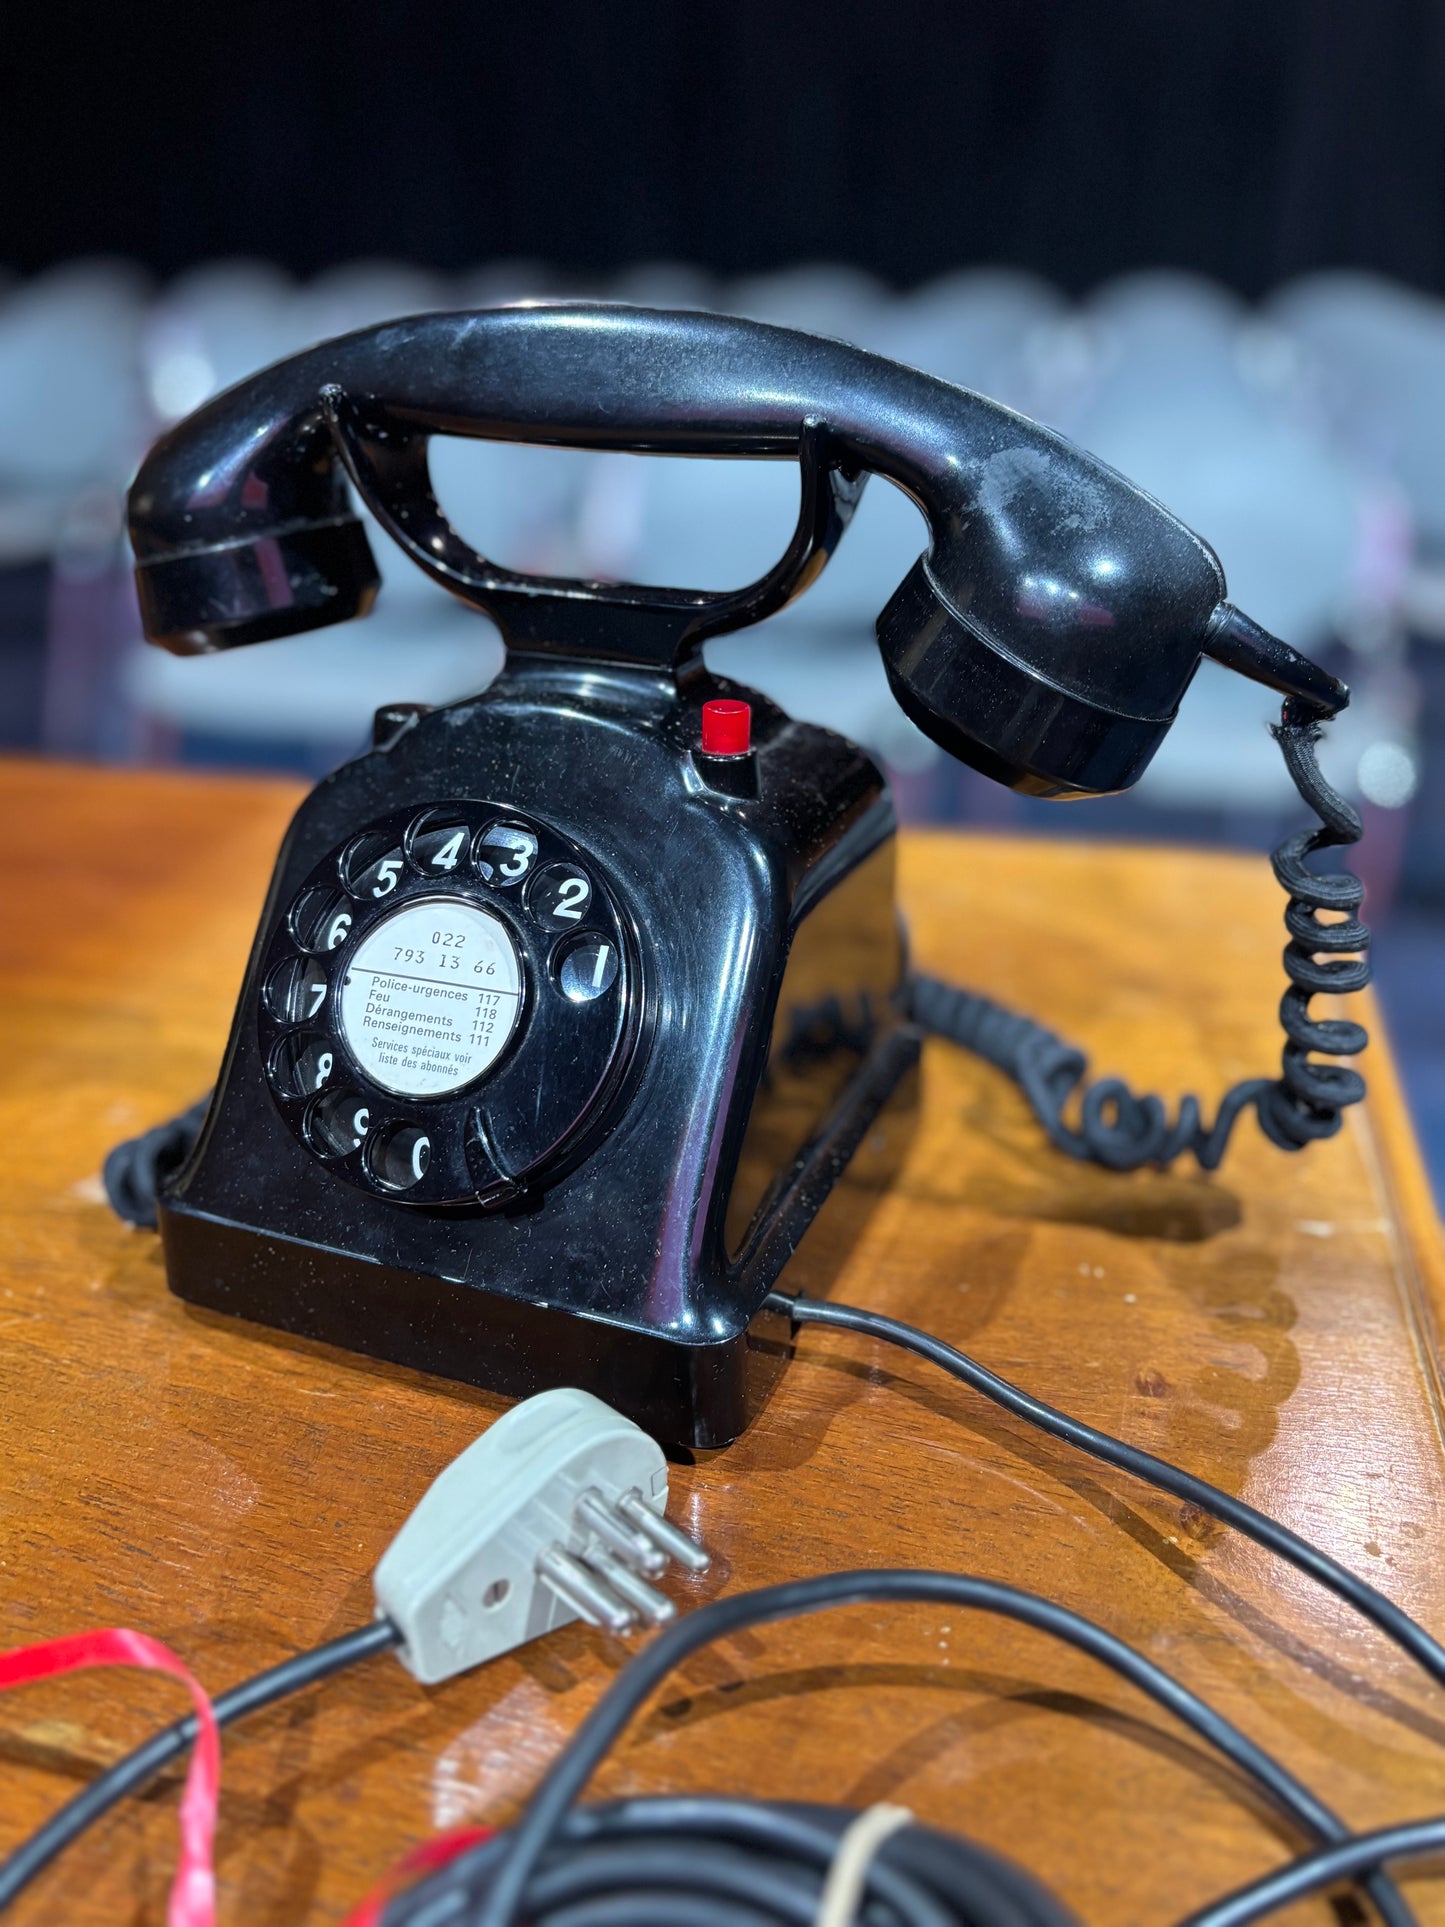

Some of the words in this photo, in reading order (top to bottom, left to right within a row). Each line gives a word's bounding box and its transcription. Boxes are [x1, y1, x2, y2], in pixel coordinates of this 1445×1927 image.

[432, 832, 464, 869] 4
[500, 840, 534, 877] 3
[372, 860, 404, 898] 5
[554, 878, 589, 919] 2
[328, 914, 352, 950] 6
[432, 931, 466, 948] 022
[394, 947, 425, 964] 793
[439, 954, 460, 970] 13
[474, 960, 496, 976] 66
[592, 945, 610, 988] 1
[309, 984, 327, 1017] 7
[368, 990, 390, 1002] Feu
[475, 1007, 498, 1020] 118
[372, 976, 468, 1001] Police-urgences
[478, 993, 500, 1006] 117
[362, 1016, 462, 1042] Renseignements
[470, 1034, 490, 1047] 111
[366, 1002, 453, 1027] Dérangements
[472, 1020, 494, 1034] 112
[372, 1037, 408, 1053] Services
[412, 1045, 450, 1060] spéciaux
[454, 1052, 472, 1064] voir
[378, 1052, 398, 1065] liste
[402, 1056, 416, 1069] des
[420, 1061, 458, 1076] abonnés
[316, 1053, 334, 1089] 8
